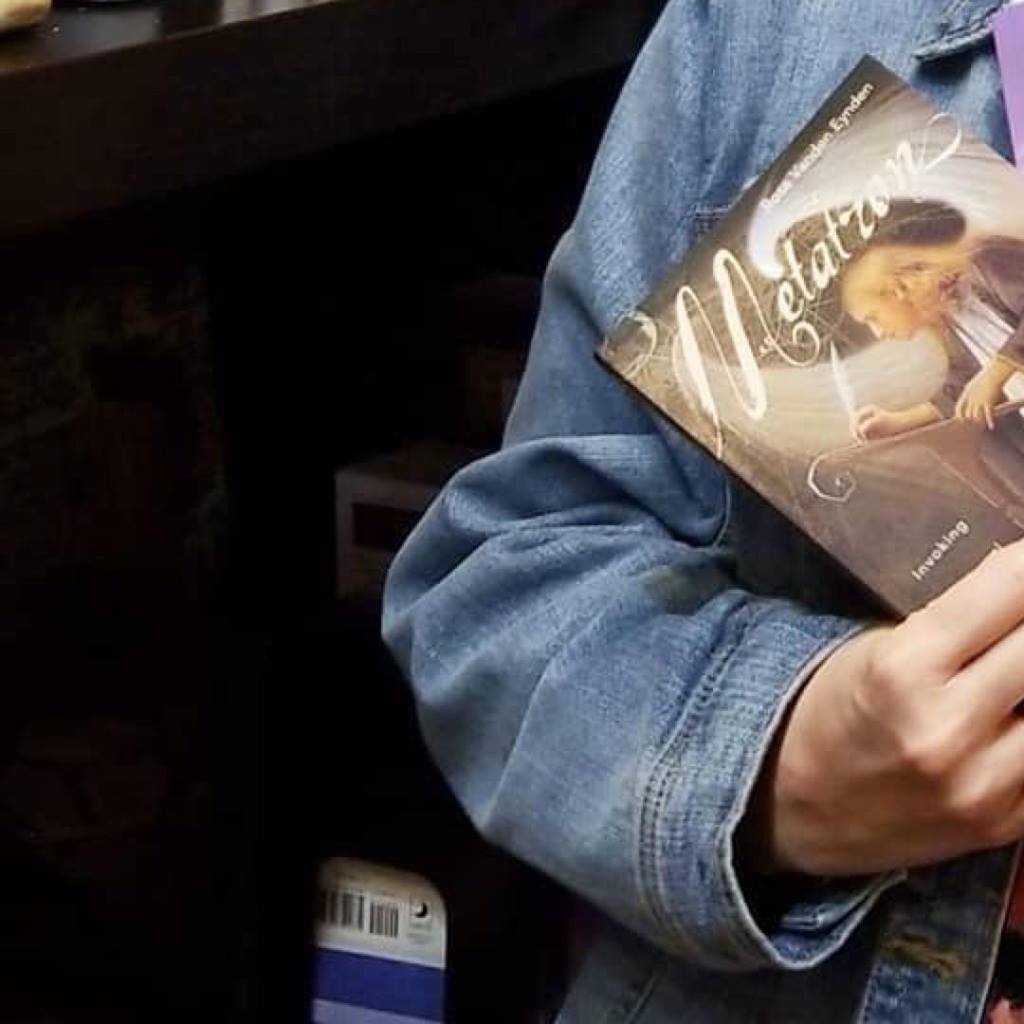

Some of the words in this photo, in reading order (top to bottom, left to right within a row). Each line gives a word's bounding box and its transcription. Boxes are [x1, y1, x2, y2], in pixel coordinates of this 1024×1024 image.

[827, 82, 875, 132] Eynden
[640, 112, 963, 460] Metatron
[911, 519, 971, 582] Invoking
